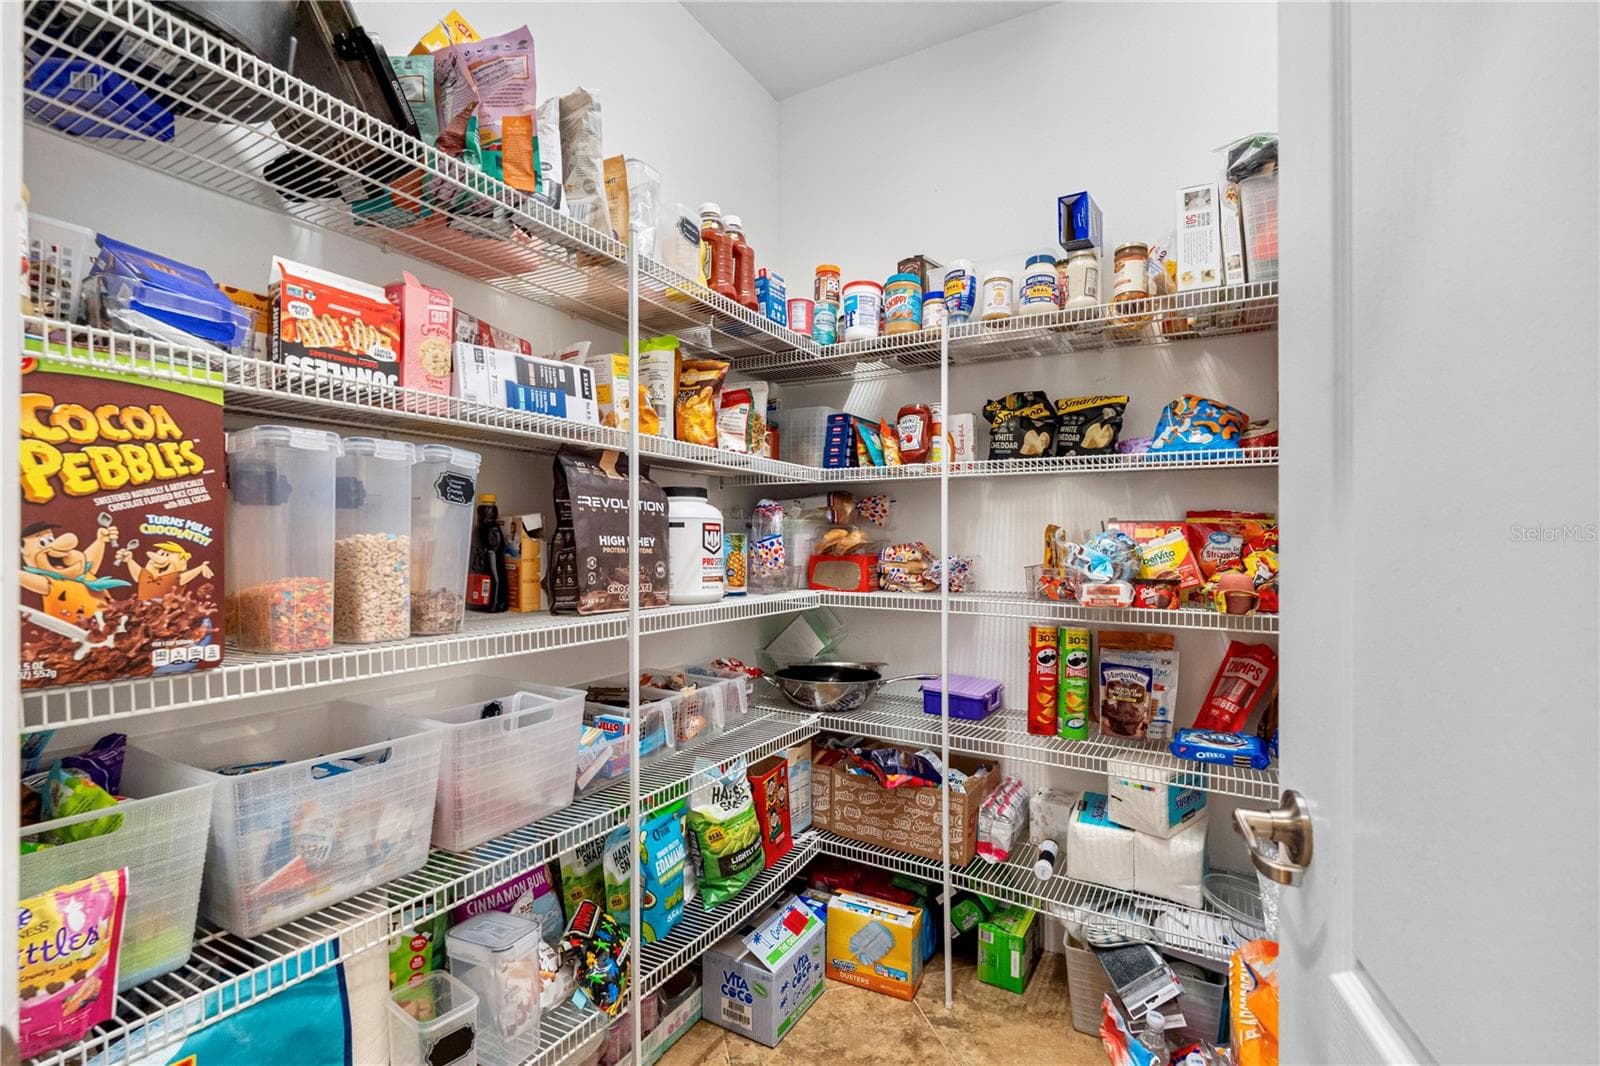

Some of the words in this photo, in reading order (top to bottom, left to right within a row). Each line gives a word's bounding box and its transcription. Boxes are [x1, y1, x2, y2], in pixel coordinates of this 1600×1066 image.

[885, 296, 908, 311] SKIPPY
[19, 392, 184, 444] COCOA
[19, 438, 205, 504] PEBBLES
[144, 513, 186, 528] TURNS
[183, 518, 213, 537] MILK
[599, 535, 625, 547] HIGH
[1196, 751, 1226, 759] OREO
[466, 881, 527, 916] CINNAMON
[527, 871, 546, 889] BUN
[722, 970, 750, 992] VITA
[839, 971, 870, 985] DUSTERS
[720, 983, 754, 1005] COCO
